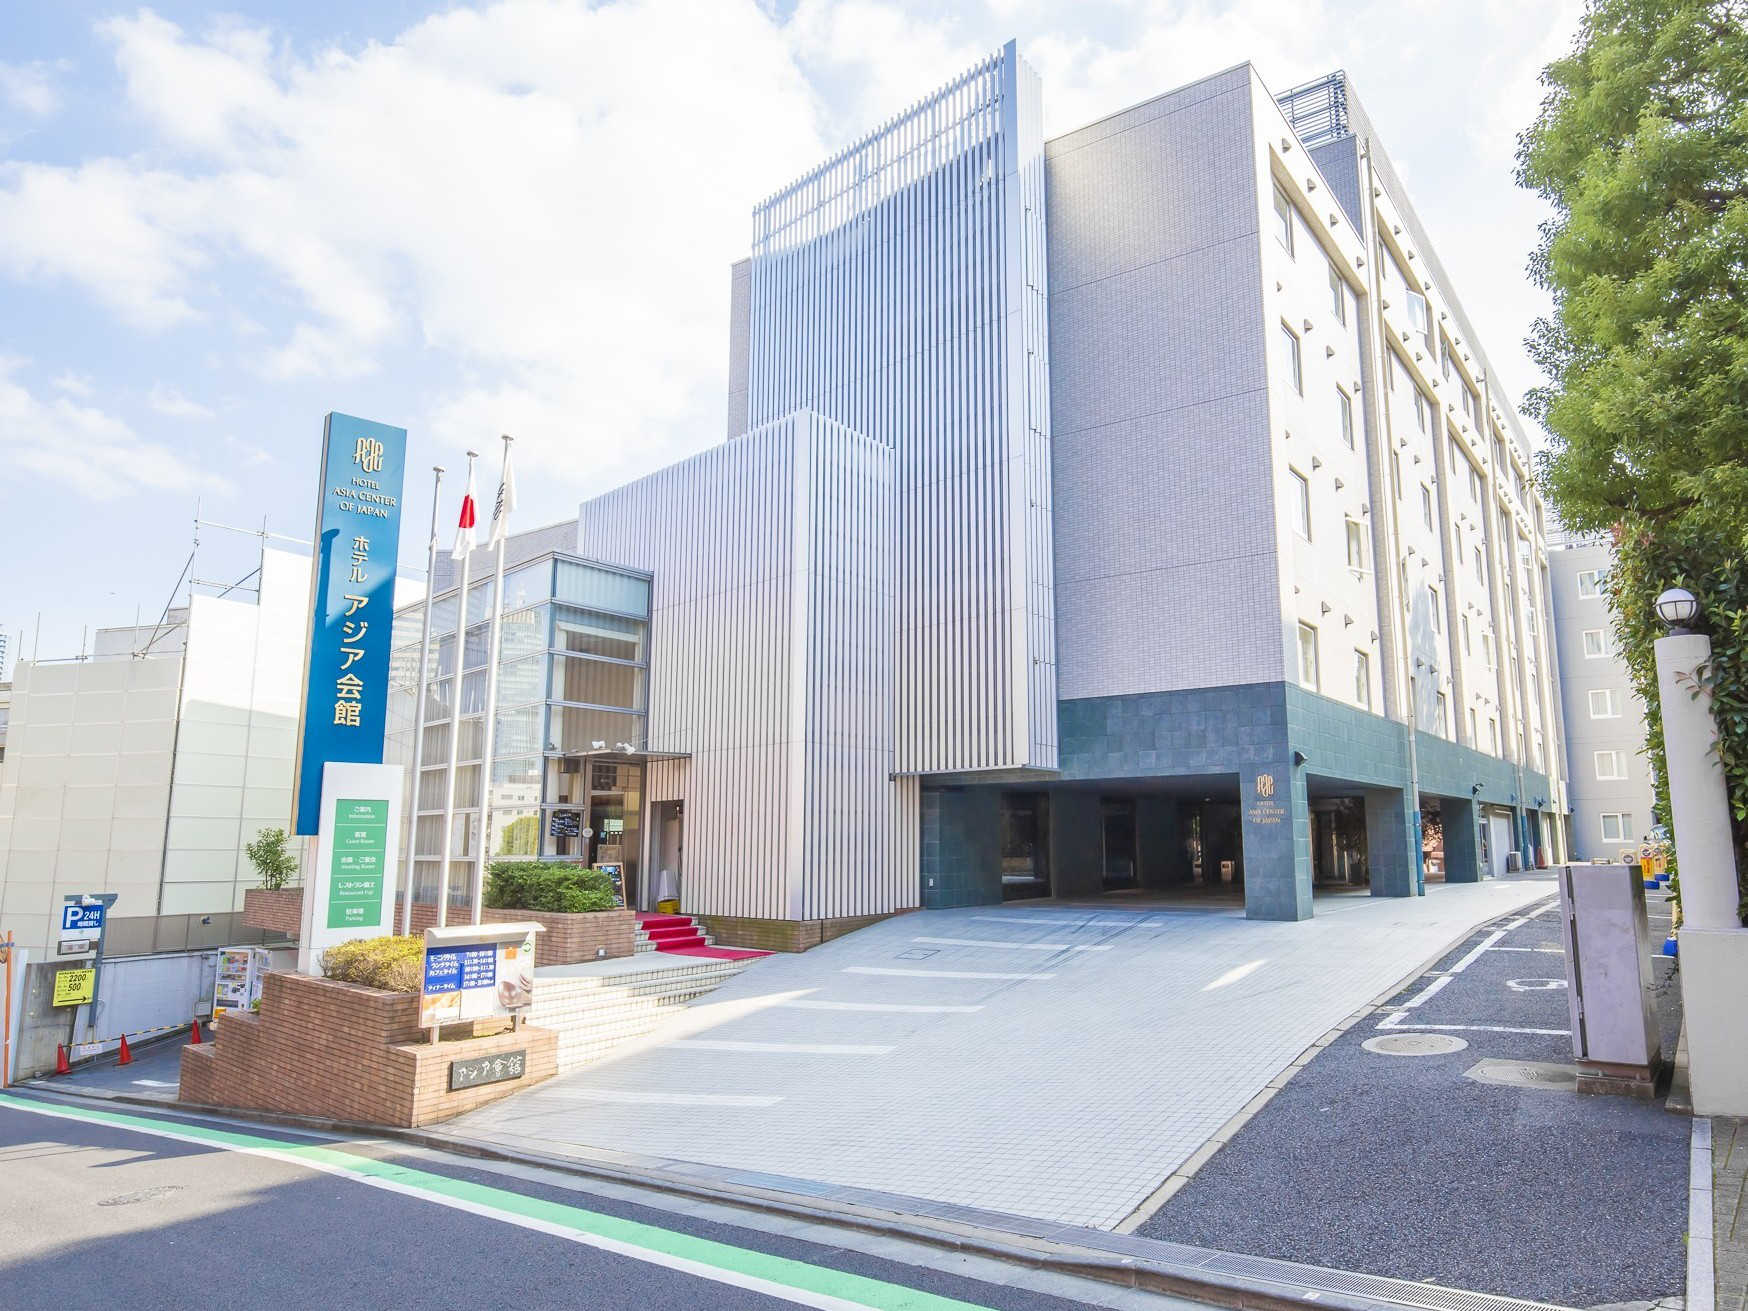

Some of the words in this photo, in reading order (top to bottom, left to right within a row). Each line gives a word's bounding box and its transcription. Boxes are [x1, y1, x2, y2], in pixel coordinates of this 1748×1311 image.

[351, 476, 381, 490] HOTEL
[332, 487, 357, 500] ASIA
[358, 490, 397, 507] CENTER
[338, 501, 356, 512] OF
[356, 504, 389, 519] JAPAN
[348, 535, 369, 584] ホテル
[333, 594, 369, 728] アジア会館
[65, 906, 84, 929] P
[84, 911, 100, 921] 24H
[67, 983, 82, 992] 500
[68, 974, 87, 983] 2200
